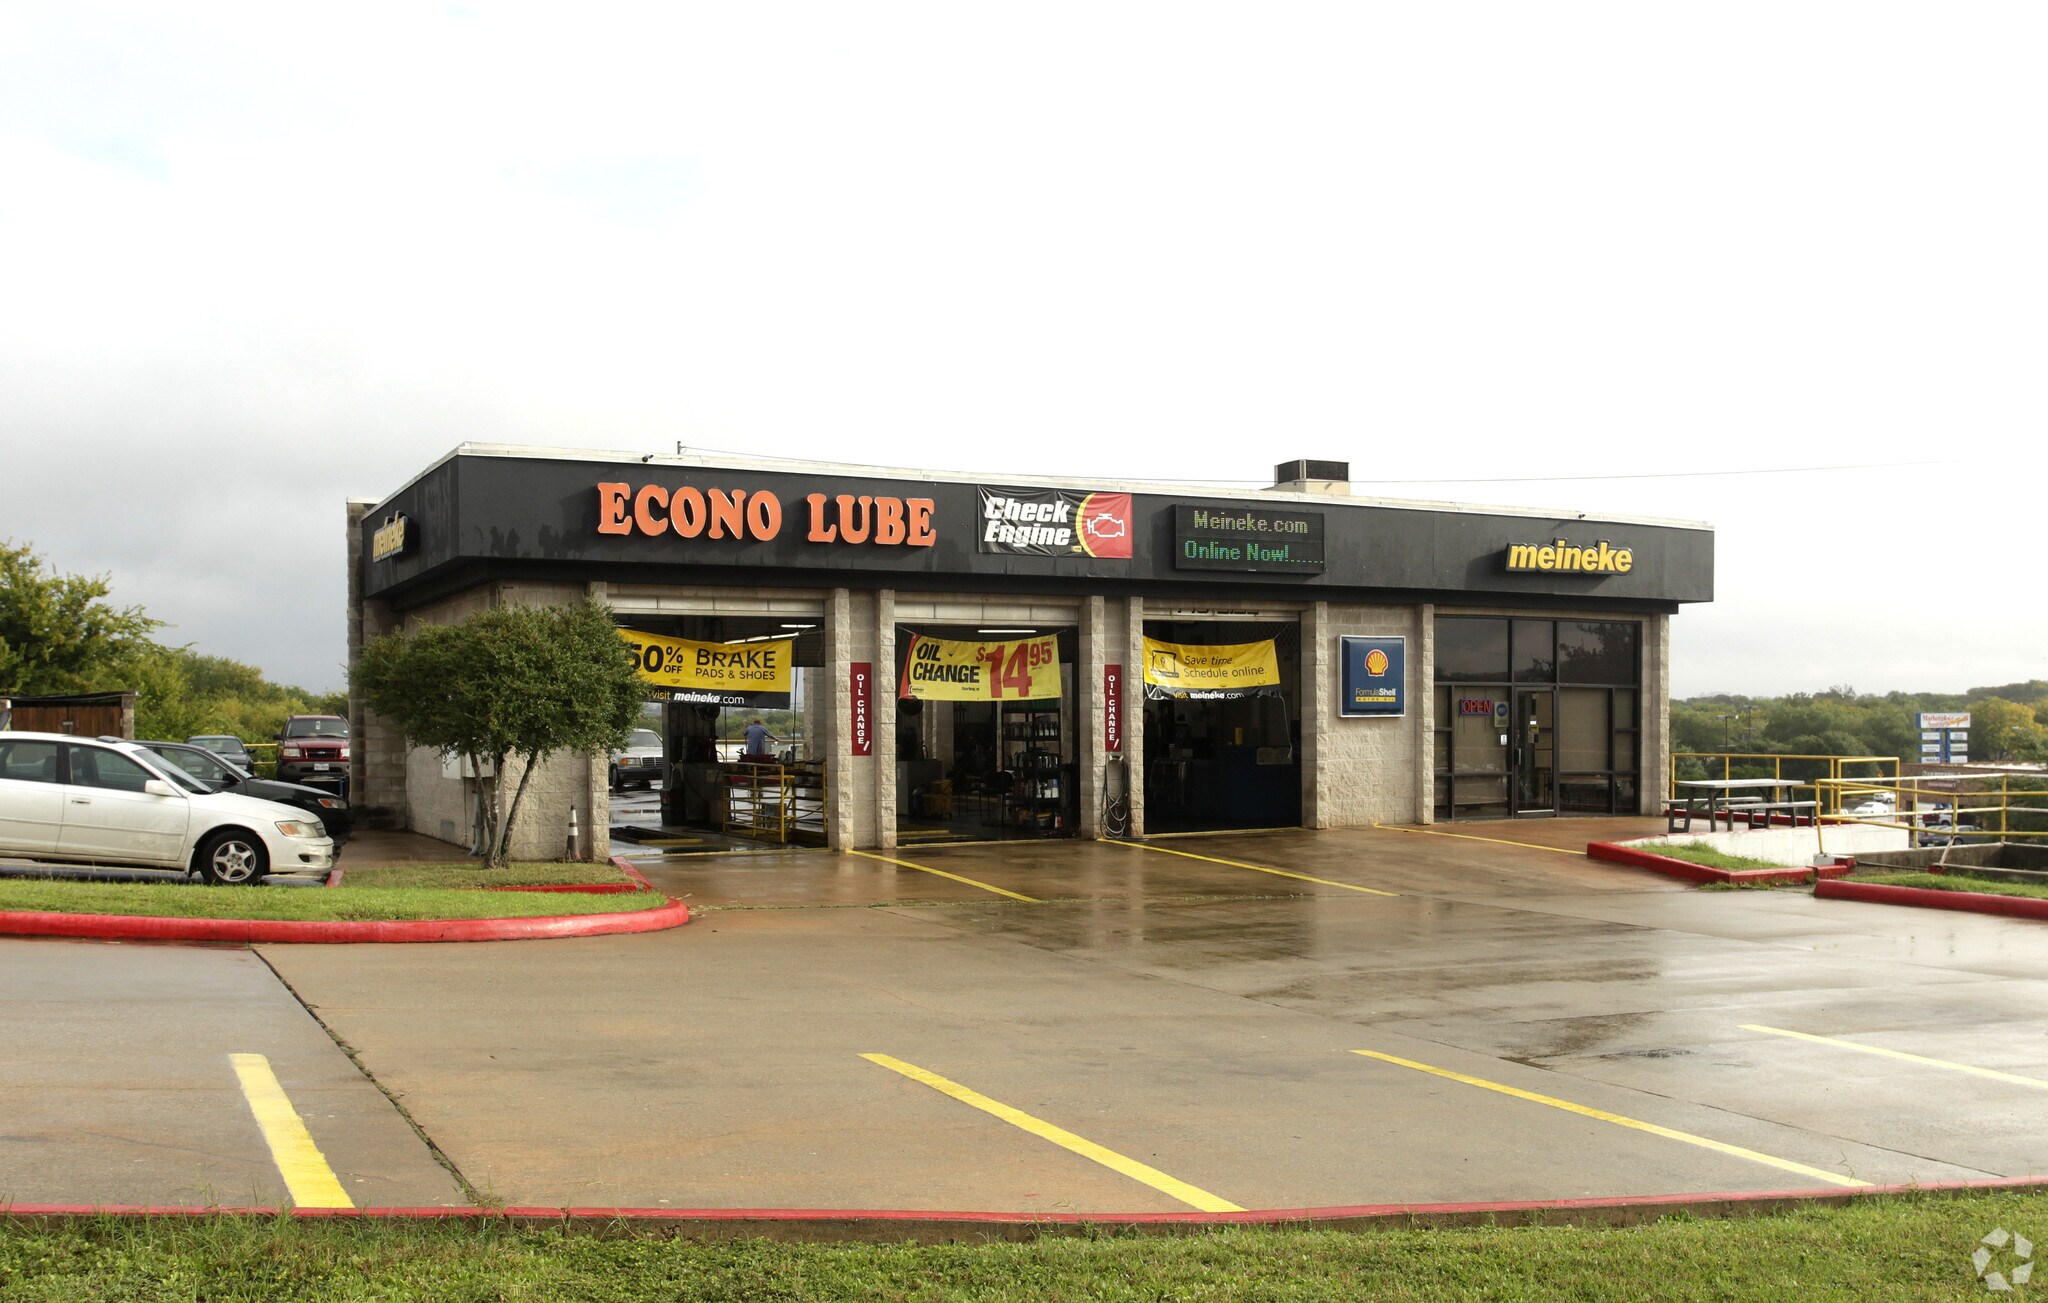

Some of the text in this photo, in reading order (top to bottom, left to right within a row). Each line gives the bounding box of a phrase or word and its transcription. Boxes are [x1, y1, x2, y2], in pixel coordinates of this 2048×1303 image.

[597, 482, 937, 547] ECONO LUBE
[984, 496, 1071, 523] Check
[1193, 510, 1309, 534] Meineke.com
[983, 520, 1072, 548] Engine
[1184, 540, 1241, 560] Online
[1508, 540, 1633, 573] meineke
[696, 648, 776, 669] BRAKE
[916, 642, 942, 662] OIL
[1184, 655, 1208, 666] Save
[663, 664, 683, 674] OFF
[695, 667, 776, 681] PADS & SHOES
[912, 661, 981, 684] CHANGE
[1183, 668, 1229, 678] Schedule
[651, 690, 745, 705] visit meineke.com
[1108, 675, 1116, 741] OIL CHANGE
[1462, 700, 1492, 713] OPEN
[856, 673, 865, 745] OIL CHANGE
